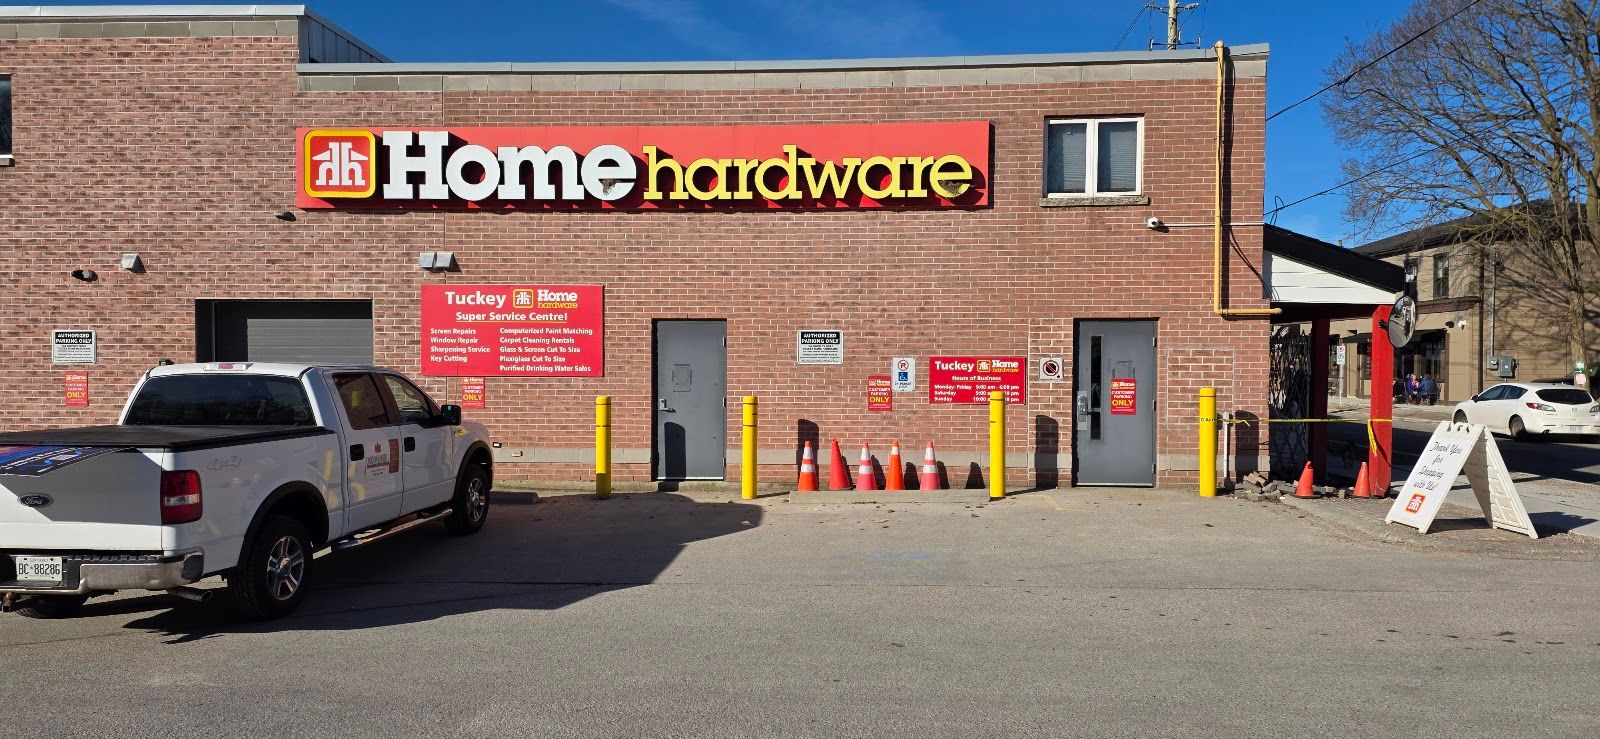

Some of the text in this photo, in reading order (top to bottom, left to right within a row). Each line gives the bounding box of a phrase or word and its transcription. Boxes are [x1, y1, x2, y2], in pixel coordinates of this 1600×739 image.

[382, 130, 973, 201] Home hardware
[445, 291, 507, 308] Tuckey
[537, 289, 577, 302] Home
[456, 311, 568, 322] Super Service Centre!
[453, 328, 477, 336] Repairs
[562, 328, 593, 336] Matching
[457, 337, 479, 345] Repair
[522, 337, 550, 345] Cleaning
[443, 355, 468, 363] Cutting
[935, 361, 975, 372] Tuckey
[992, 360, 1019, 368] Home
[25, 496, 43, 505] Ford
[18, 562, 61, 575] BC 88286
